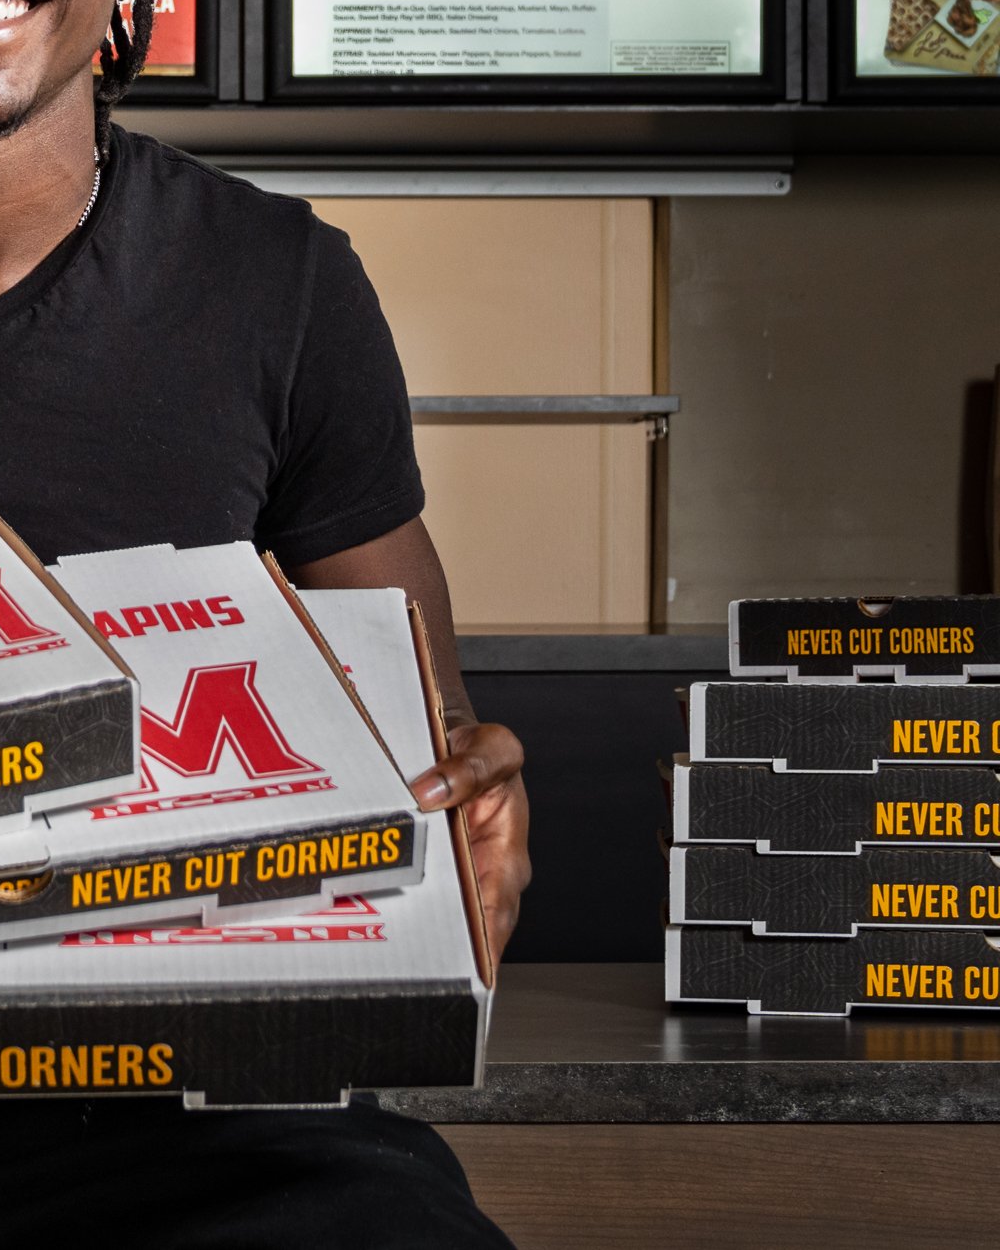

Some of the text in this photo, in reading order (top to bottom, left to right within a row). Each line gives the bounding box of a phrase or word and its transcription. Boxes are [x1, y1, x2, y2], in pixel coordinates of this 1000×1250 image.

[787, 627, 974, 656] NEVER CUT CORNERS
[893, 719, 981, 754] NEVER
[876, 802, 963, 836] NEVER
[71, 827, 401, 908] NEVER CUT CORNERS
[871, 883, 959, 918] NEVER
[866, 963, 953, 998] NEVER
